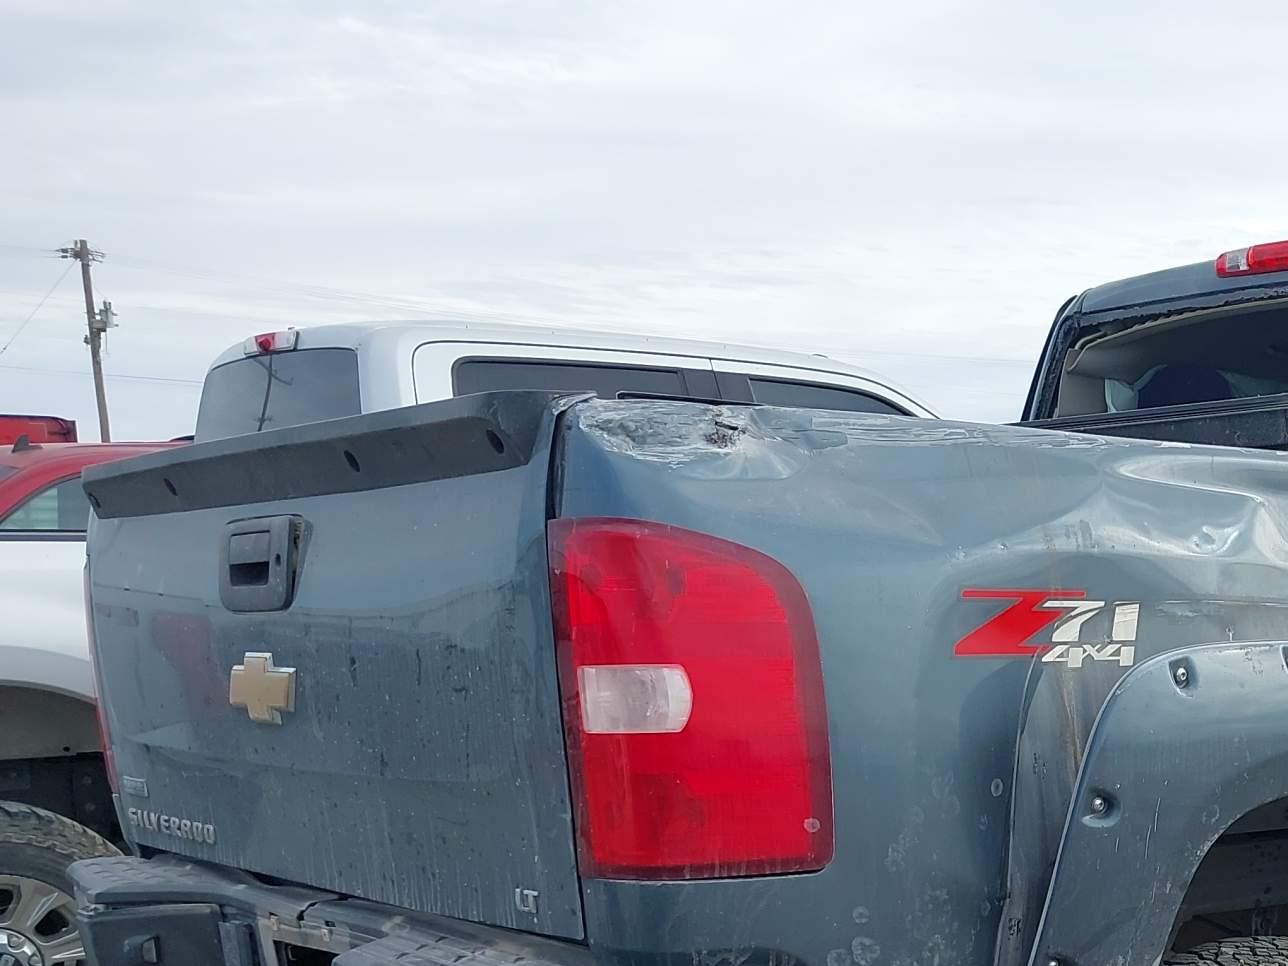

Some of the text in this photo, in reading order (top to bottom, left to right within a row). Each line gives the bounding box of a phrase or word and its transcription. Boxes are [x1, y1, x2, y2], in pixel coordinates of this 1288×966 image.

[954, 589, 1141, 657] Z71
[127, 807, 217, 845] SILVERADO
[514, 887, 539, 914] LT
